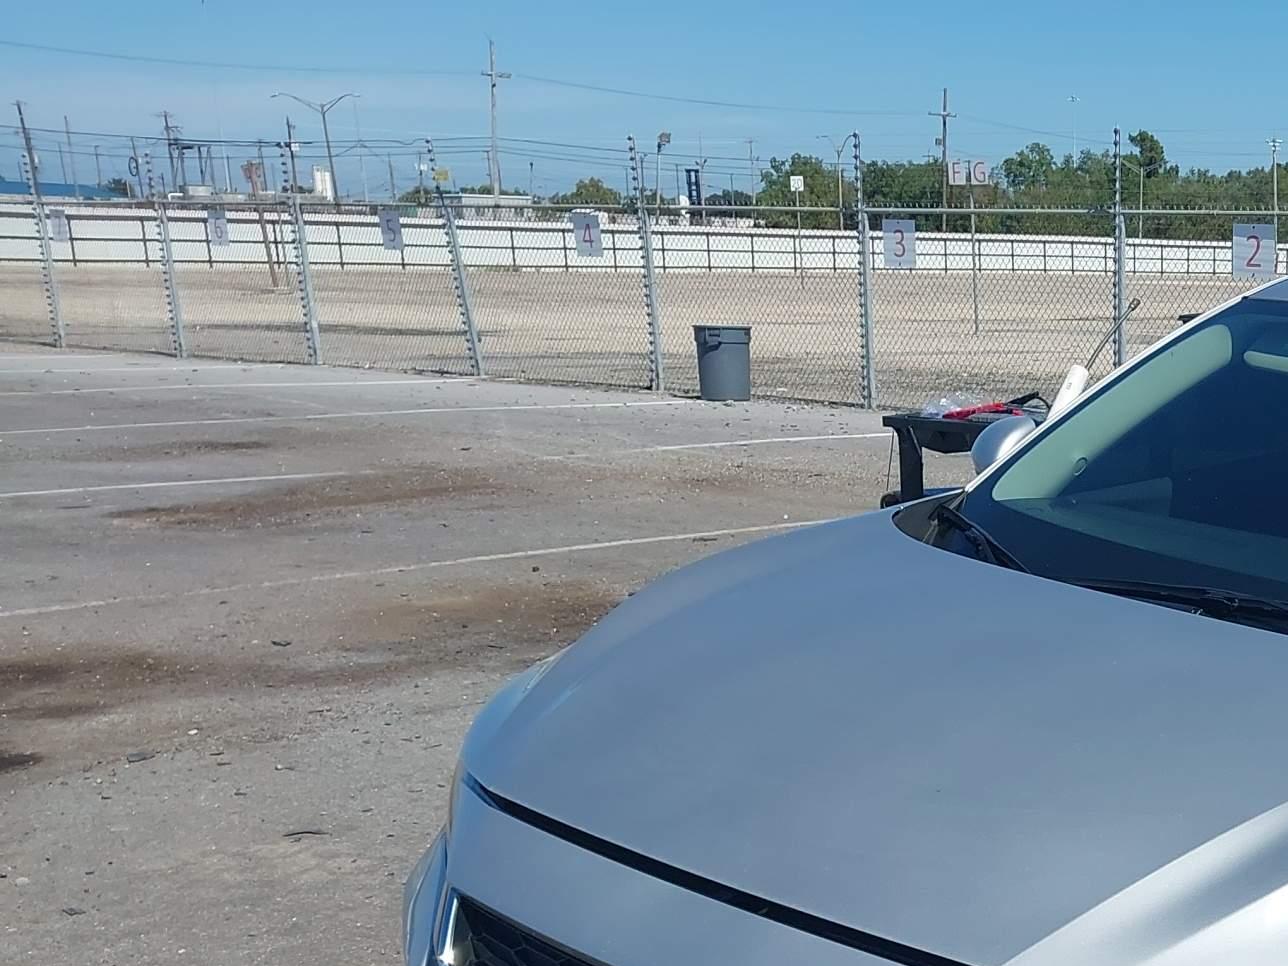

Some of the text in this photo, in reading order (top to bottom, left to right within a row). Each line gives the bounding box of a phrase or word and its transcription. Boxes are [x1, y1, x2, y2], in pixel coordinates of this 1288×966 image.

[951, 161, 961, 184] F
[973, 161, 986, 183] G
[385, 219, 396, 242] 5
[582, 223, 594, 248] 4
[893, 229, 905, 257] 3
[1246, 235, 1261, 267] 2
